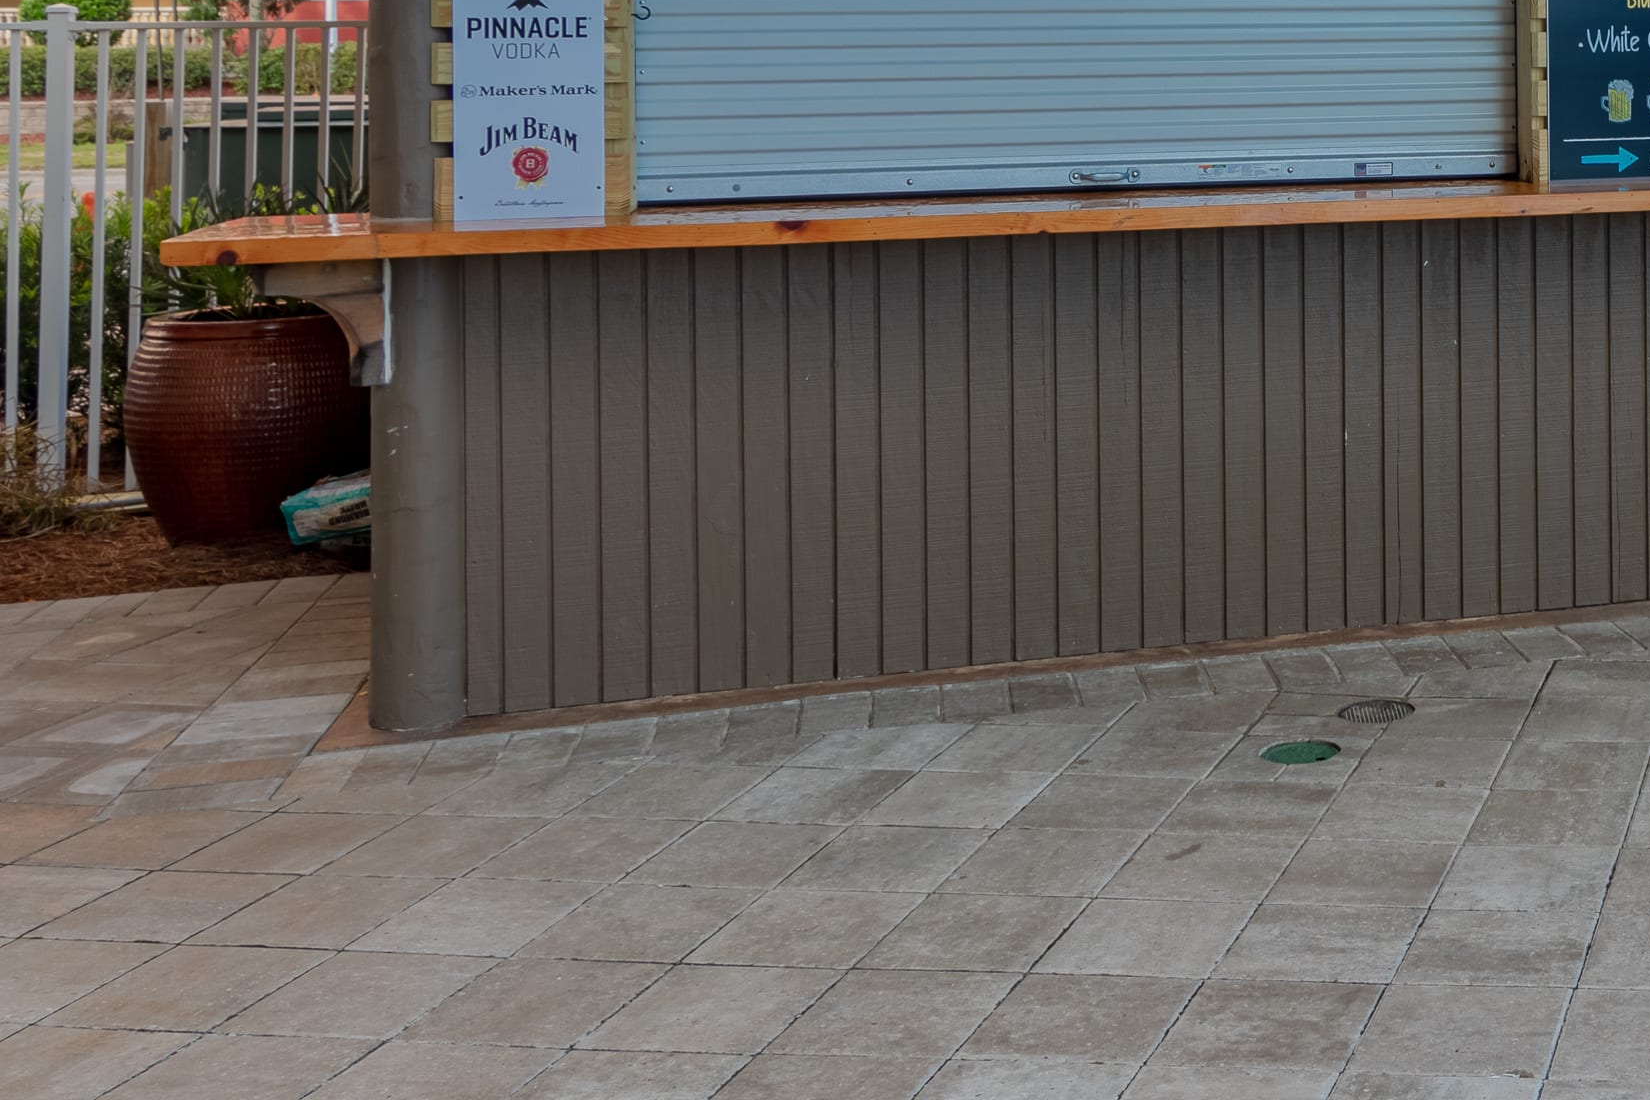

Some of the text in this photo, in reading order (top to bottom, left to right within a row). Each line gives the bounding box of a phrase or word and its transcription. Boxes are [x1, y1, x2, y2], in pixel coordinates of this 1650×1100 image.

[466, 16, 588, 39] PINNACLE
[1587, 25, 1640, 53] White
[491, 42, 561, 59] VODKA
[479, 84, 596, 96] Maker's Mark
[479, 116, 579, 156] JIM BEAM
